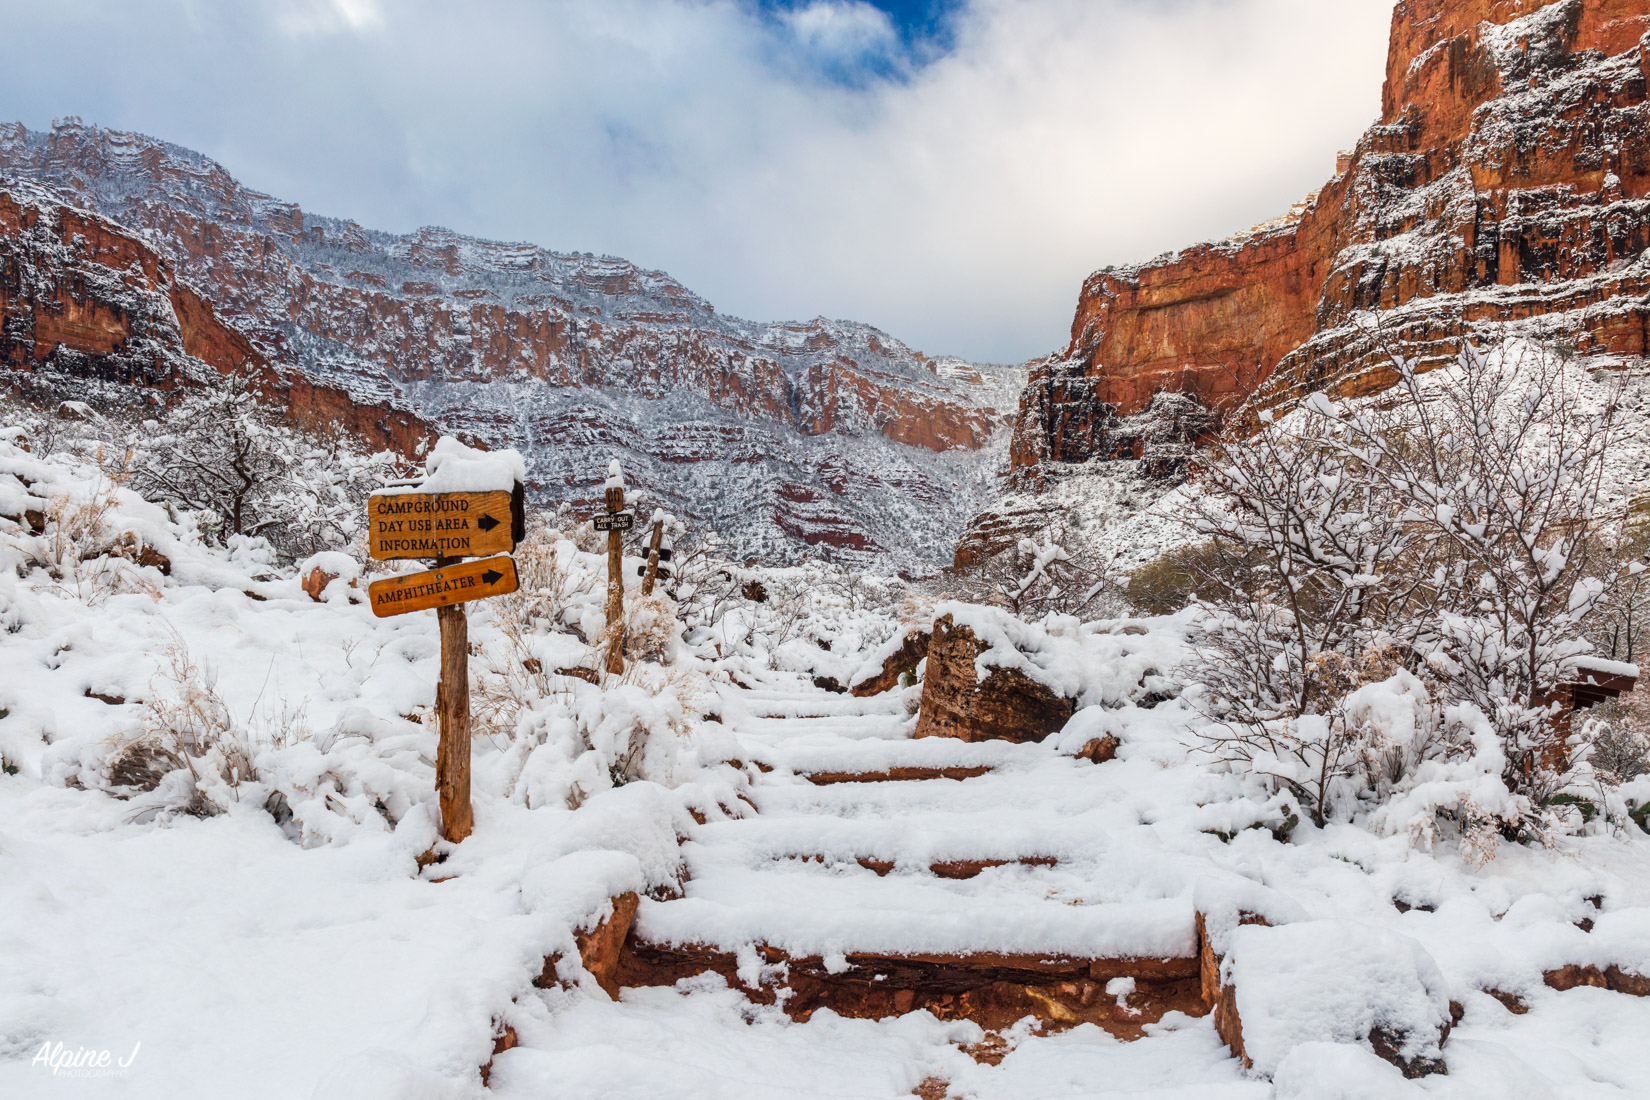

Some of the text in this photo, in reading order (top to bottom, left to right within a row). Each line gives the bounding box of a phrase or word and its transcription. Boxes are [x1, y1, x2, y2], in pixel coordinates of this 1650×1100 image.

[377, 499, 469, 515] CAMPGROUND
[379, 518, 470, 533] DAY USE AREA
[611, 521, 629, 529] TRASH
[379, 537, 470, 552] INFORMATION
[377, 575, 476, 605] AMPHITHEATER
